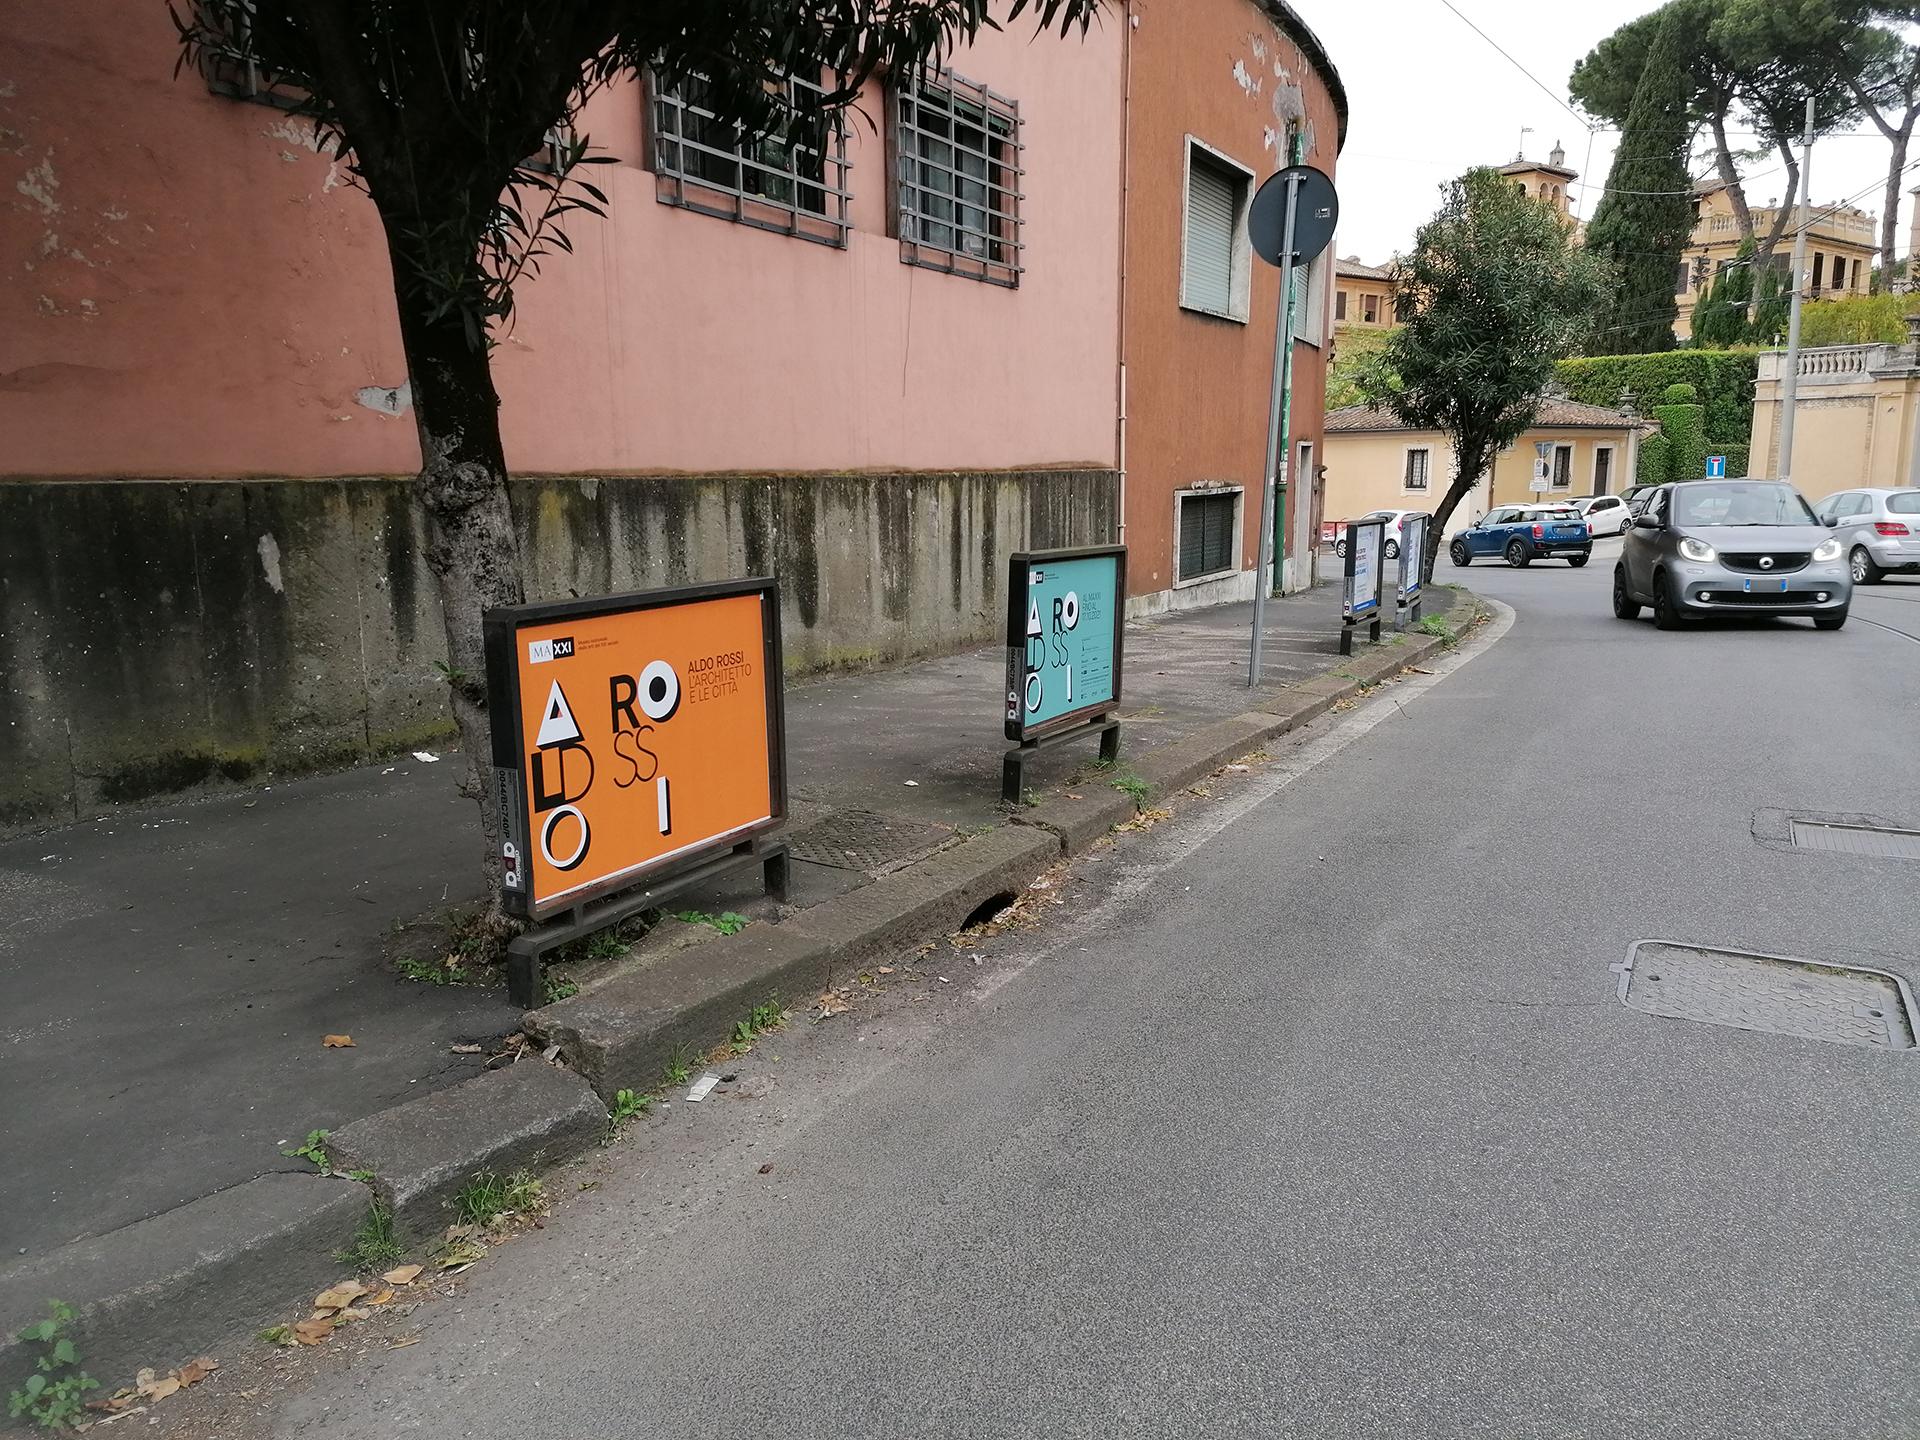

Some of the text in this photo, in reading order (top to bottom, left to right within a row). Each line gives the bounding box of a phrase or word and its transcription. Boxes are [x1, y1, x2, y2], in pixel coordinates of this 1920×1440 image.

[1027, 591, 1080, 637] A RO
[533, 640, 572, 658] MAXXI
[688, 651, 744, 674] ALDO ROSSI
[1051, 630, 1069, 668] SS
[688, 663, 752, 689] L'ARCHITETTO
[689, 689, 696, 704] E
[698, 687, 710, 702] LE
[1025, 672, 1043, 713] O
[536, 660, 682, 750] A RO
[531, 743, 596, 813] LD
[613, 725, 659, 788] SS
[541, 804, 591, 870] O
